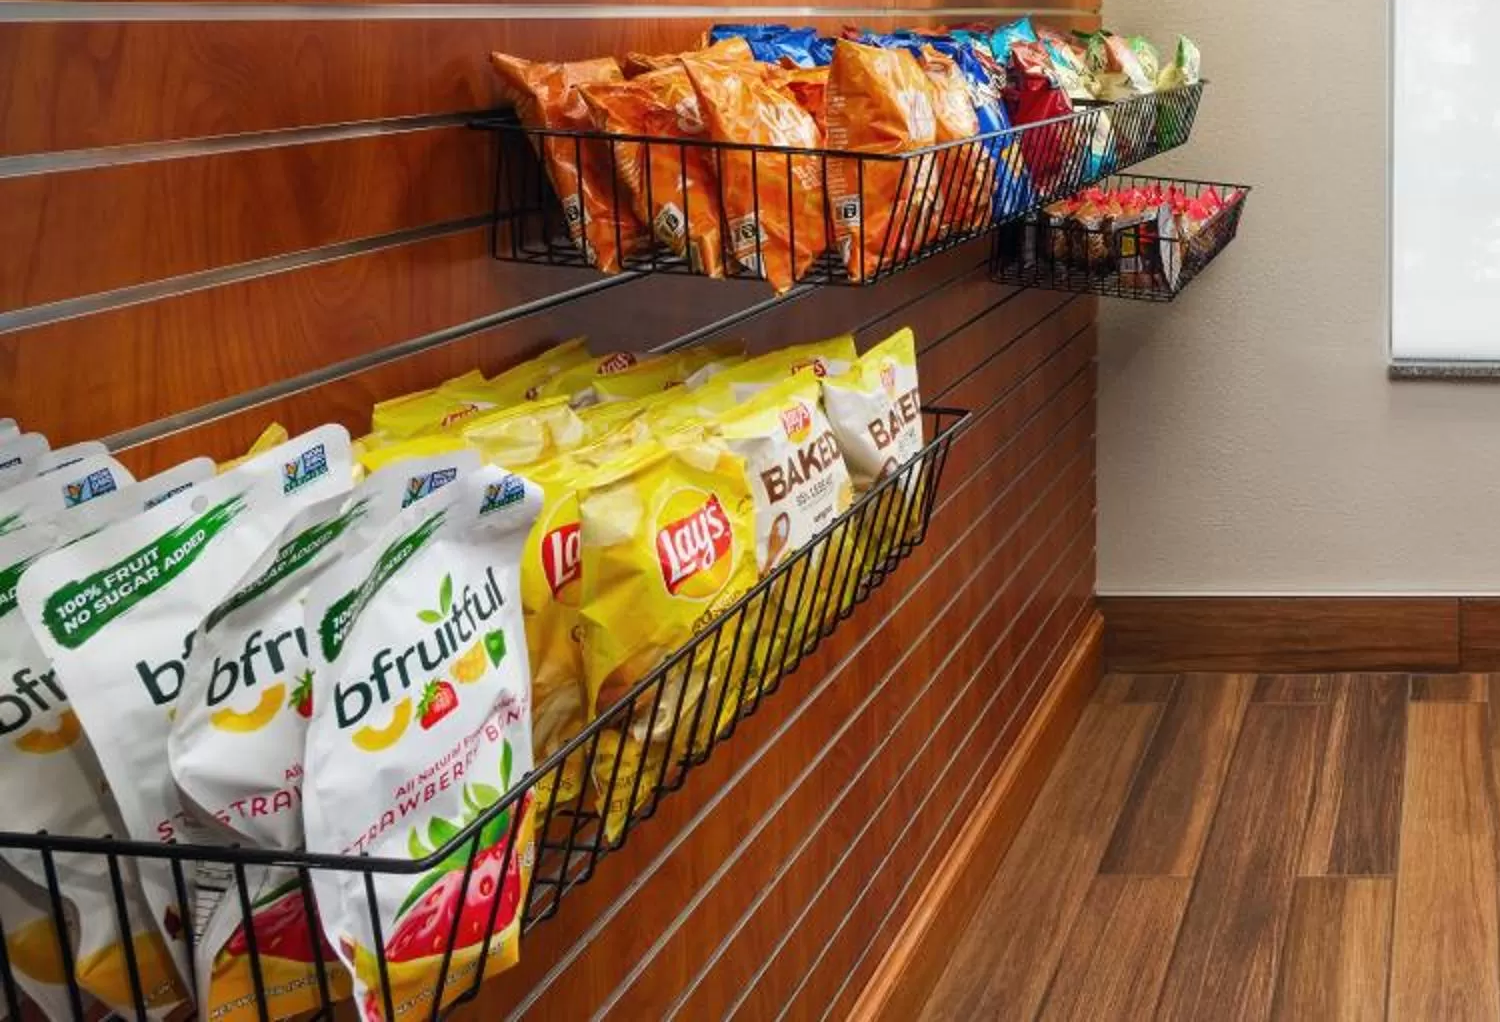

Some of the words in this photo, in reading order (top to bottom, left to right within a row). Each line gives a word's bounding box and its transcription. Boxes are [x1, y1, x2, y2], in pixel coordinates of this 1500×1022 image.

[868, 388, 921, 450] BAED
[760, 430, 840, 504] BAKED
[55, 583, 101, 618] 100%
[103, 546, 161, 588] FRUIT
[63, 607, 92, 635] NO
[93, 567, 161, 614] SUGAR
[163, 529, 207, 571] ADDED
[333, 565, 504, 730] bfruitful
